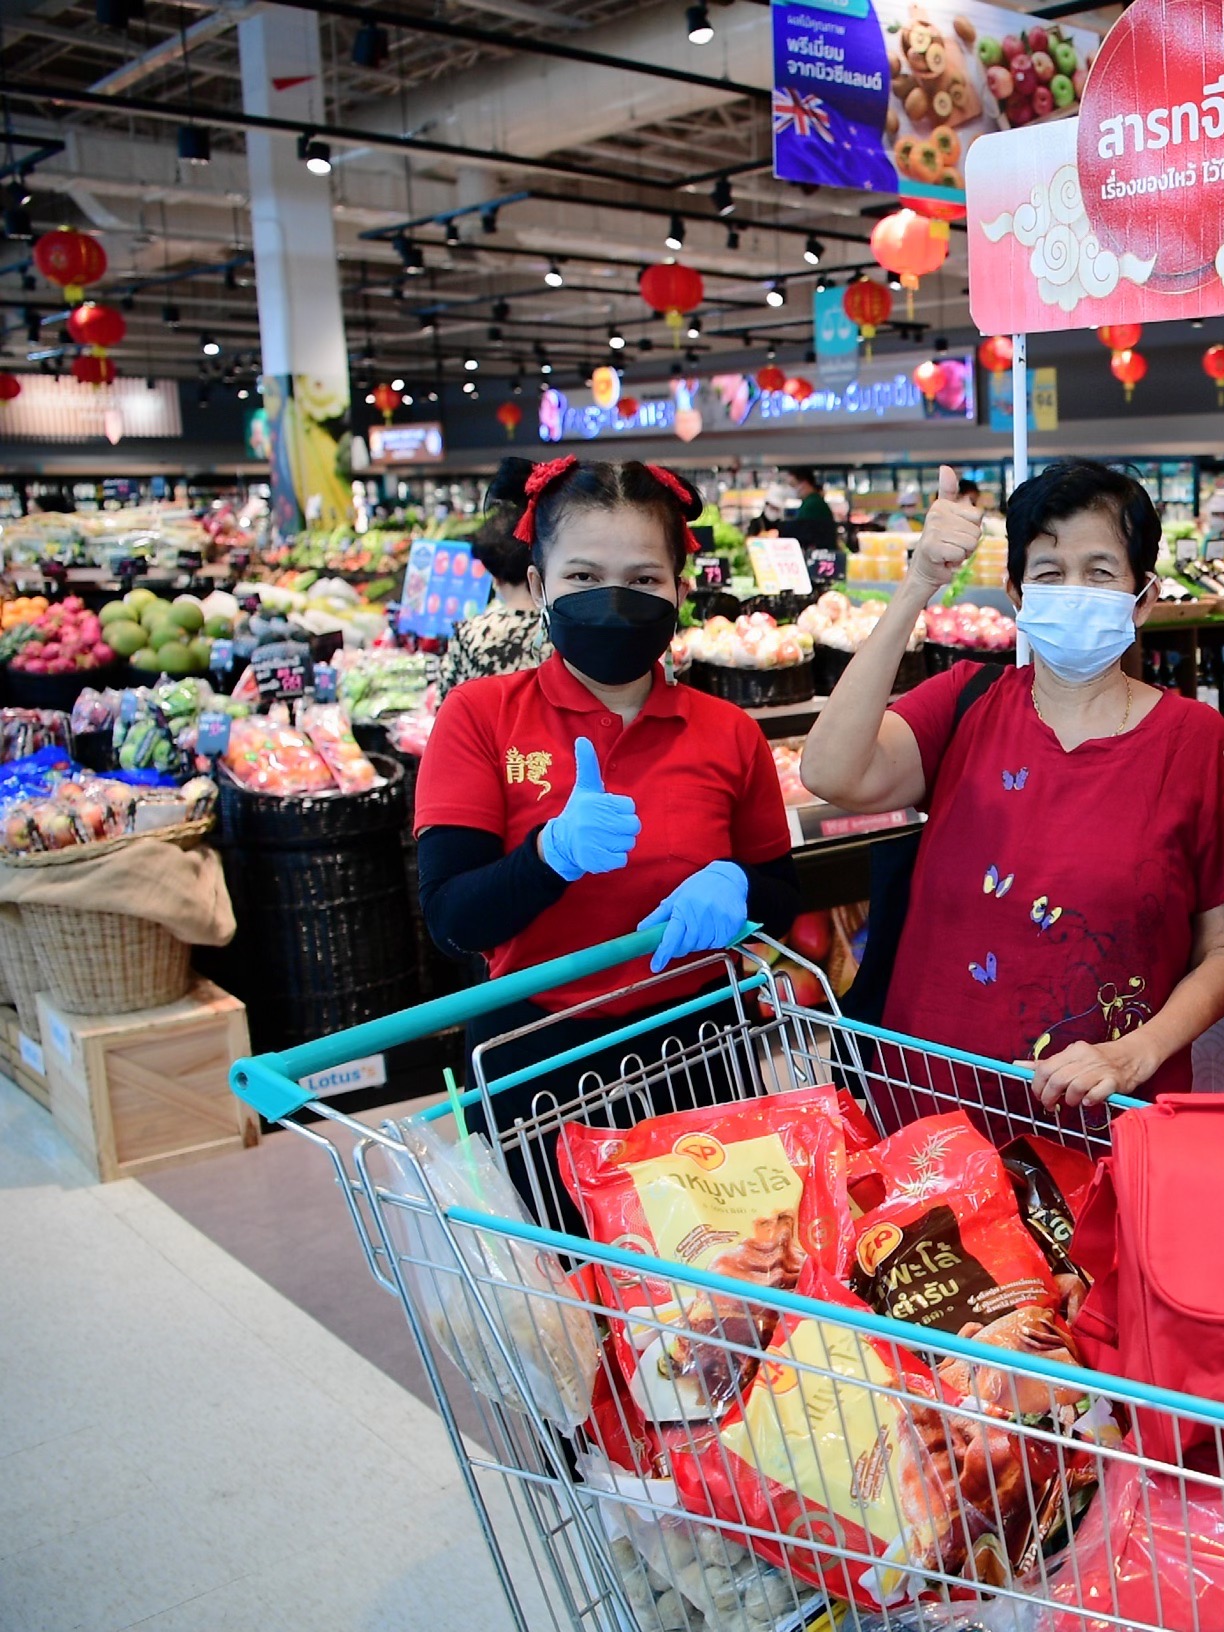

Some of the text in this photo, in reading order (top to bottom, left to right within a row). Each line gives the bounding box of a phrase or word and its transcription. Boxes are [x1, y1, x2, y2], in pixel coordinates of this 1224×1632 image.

[786, 59, 882, 91] จากนิวซีแลนด์
[1101, 162, 1198, 200] เรื่องของไหว้
[308, 1065, 376, 1091] Lotus's
[666, 1165, 792, 1205] าหมูพะโล้
